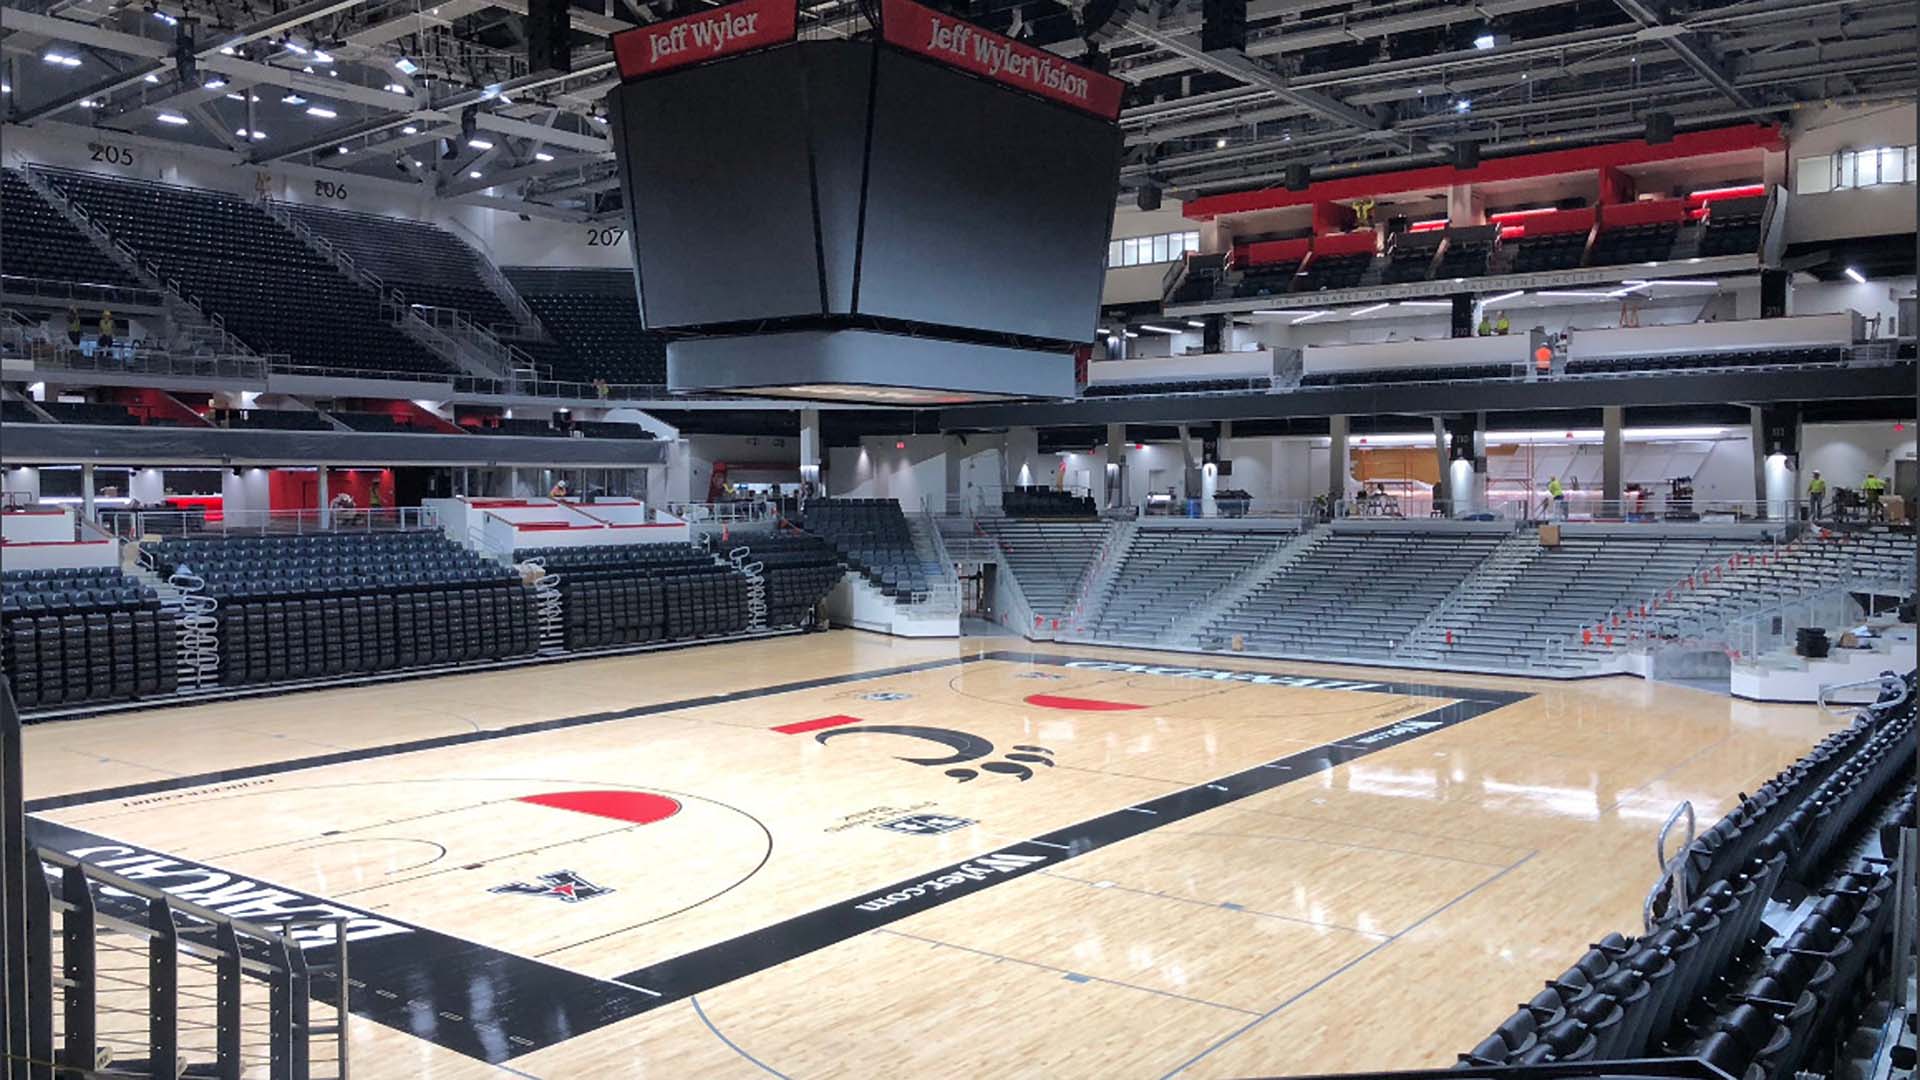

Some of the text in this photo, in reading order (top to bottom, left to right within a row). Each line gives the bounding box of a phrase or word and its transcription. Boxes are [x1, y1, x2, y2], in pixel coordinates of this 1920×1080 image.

[649, 9, 760, 64] Jeff Wyler
[929, 17, 1089, 100] Jeff WylerVision
[91, 145, 133, 166] 205
[314, 180, 347, 199] 206
[587, 229, 625, 246] 207
[855, 853, 1048, 912] Wyler.com
